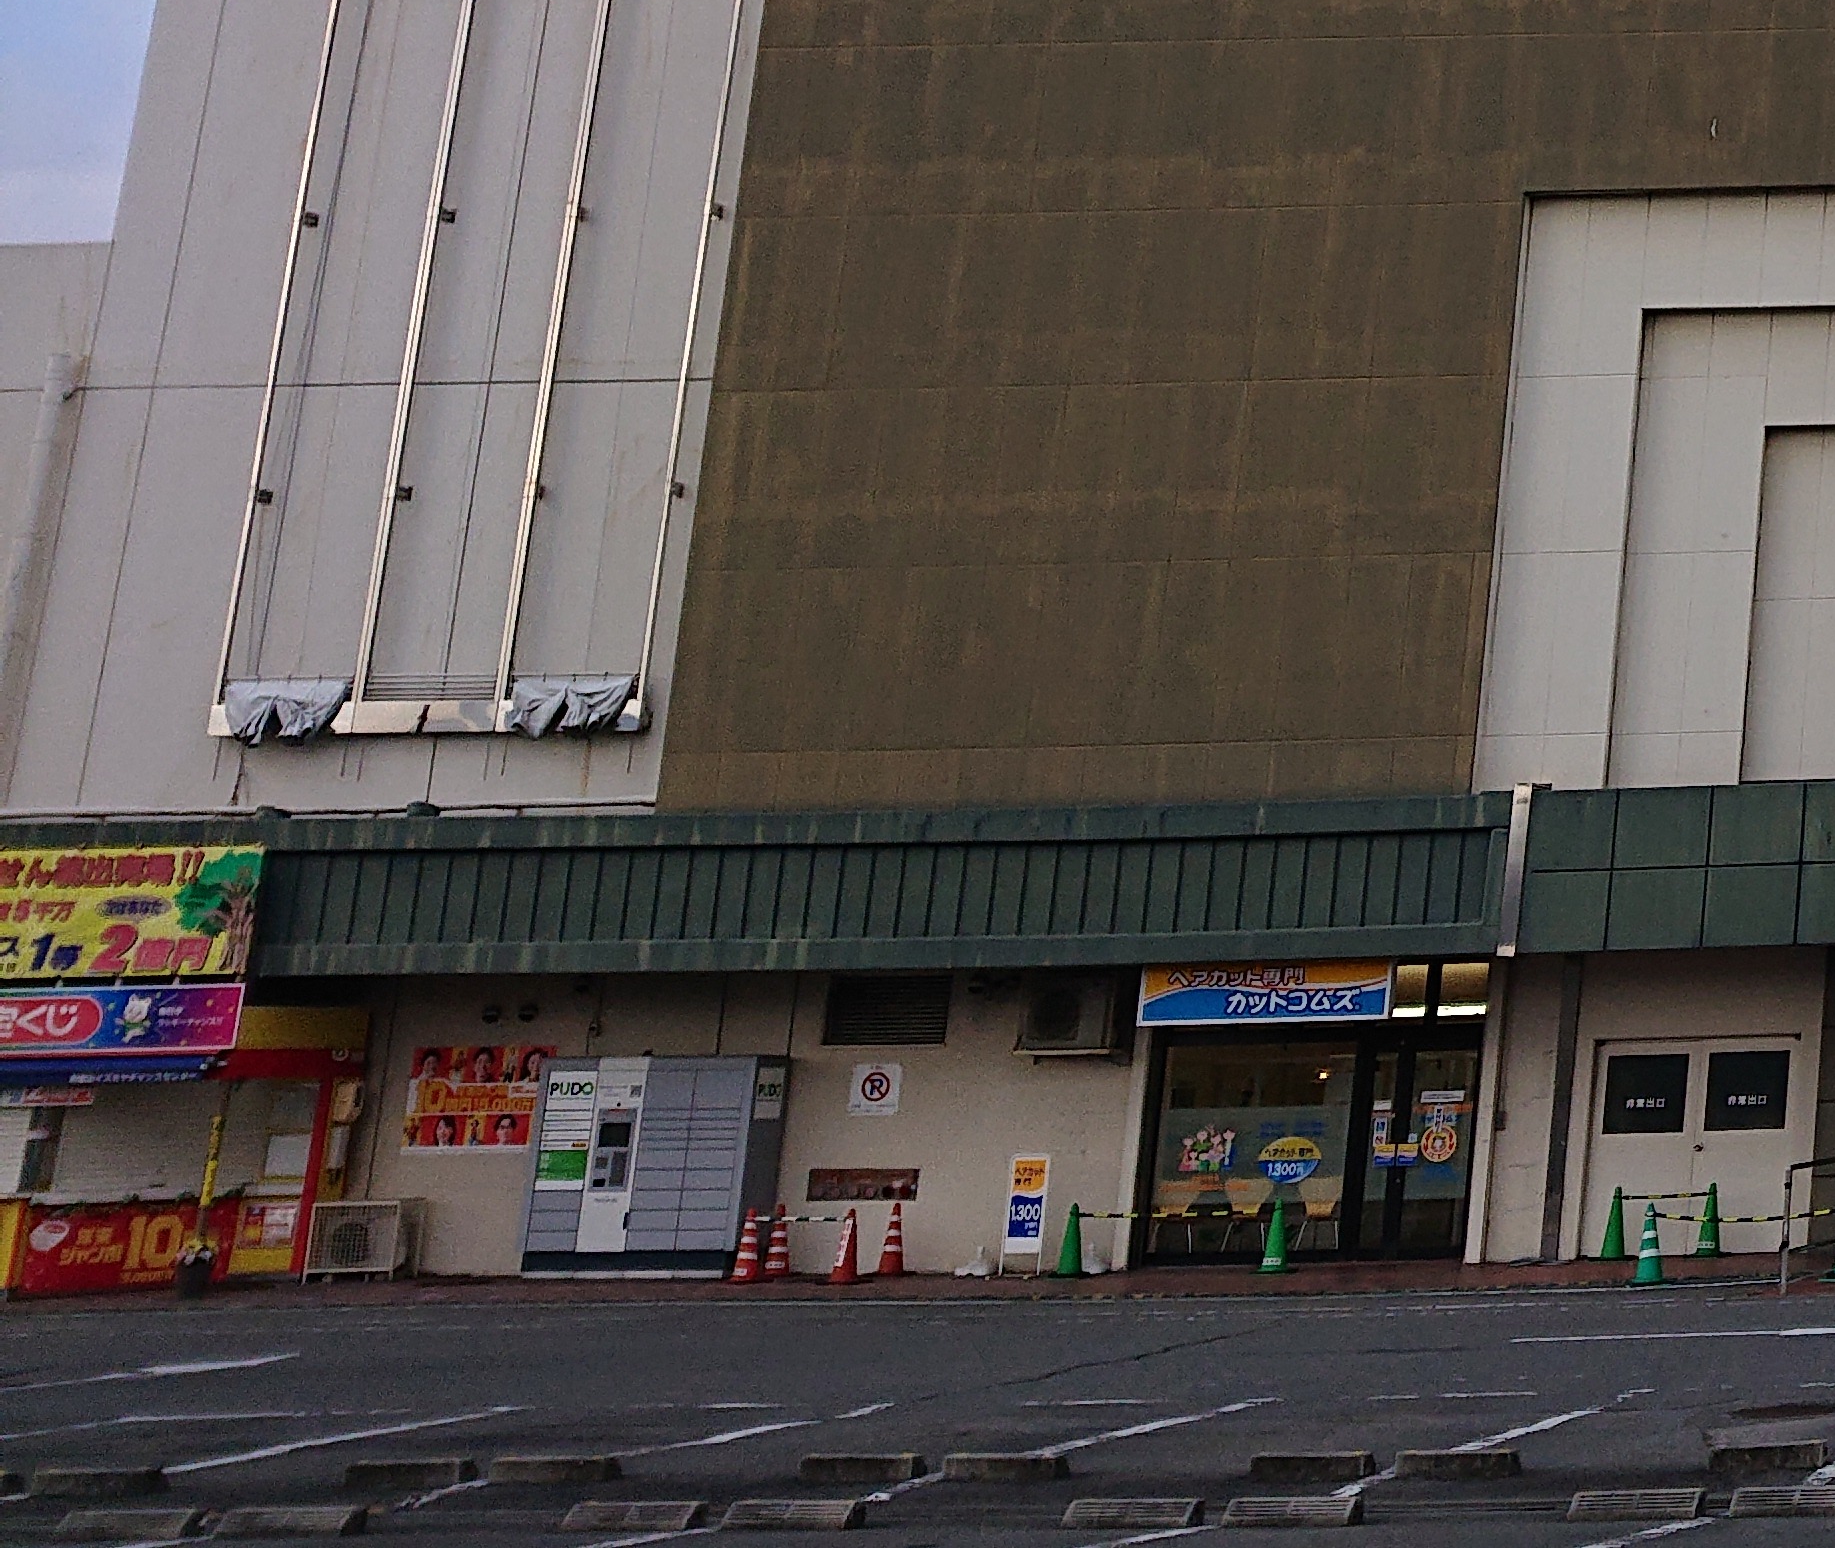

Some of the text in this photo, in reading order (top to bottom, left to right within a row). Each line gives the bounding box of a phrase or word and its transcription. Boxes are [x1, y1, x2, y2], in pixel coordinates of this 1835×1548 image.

[1168, 966, 1306, 987] ヘアカット専門
[1225, 987, 1361, 1015] カットコムズ
[550, 1081, 594, 1096] PUDO
